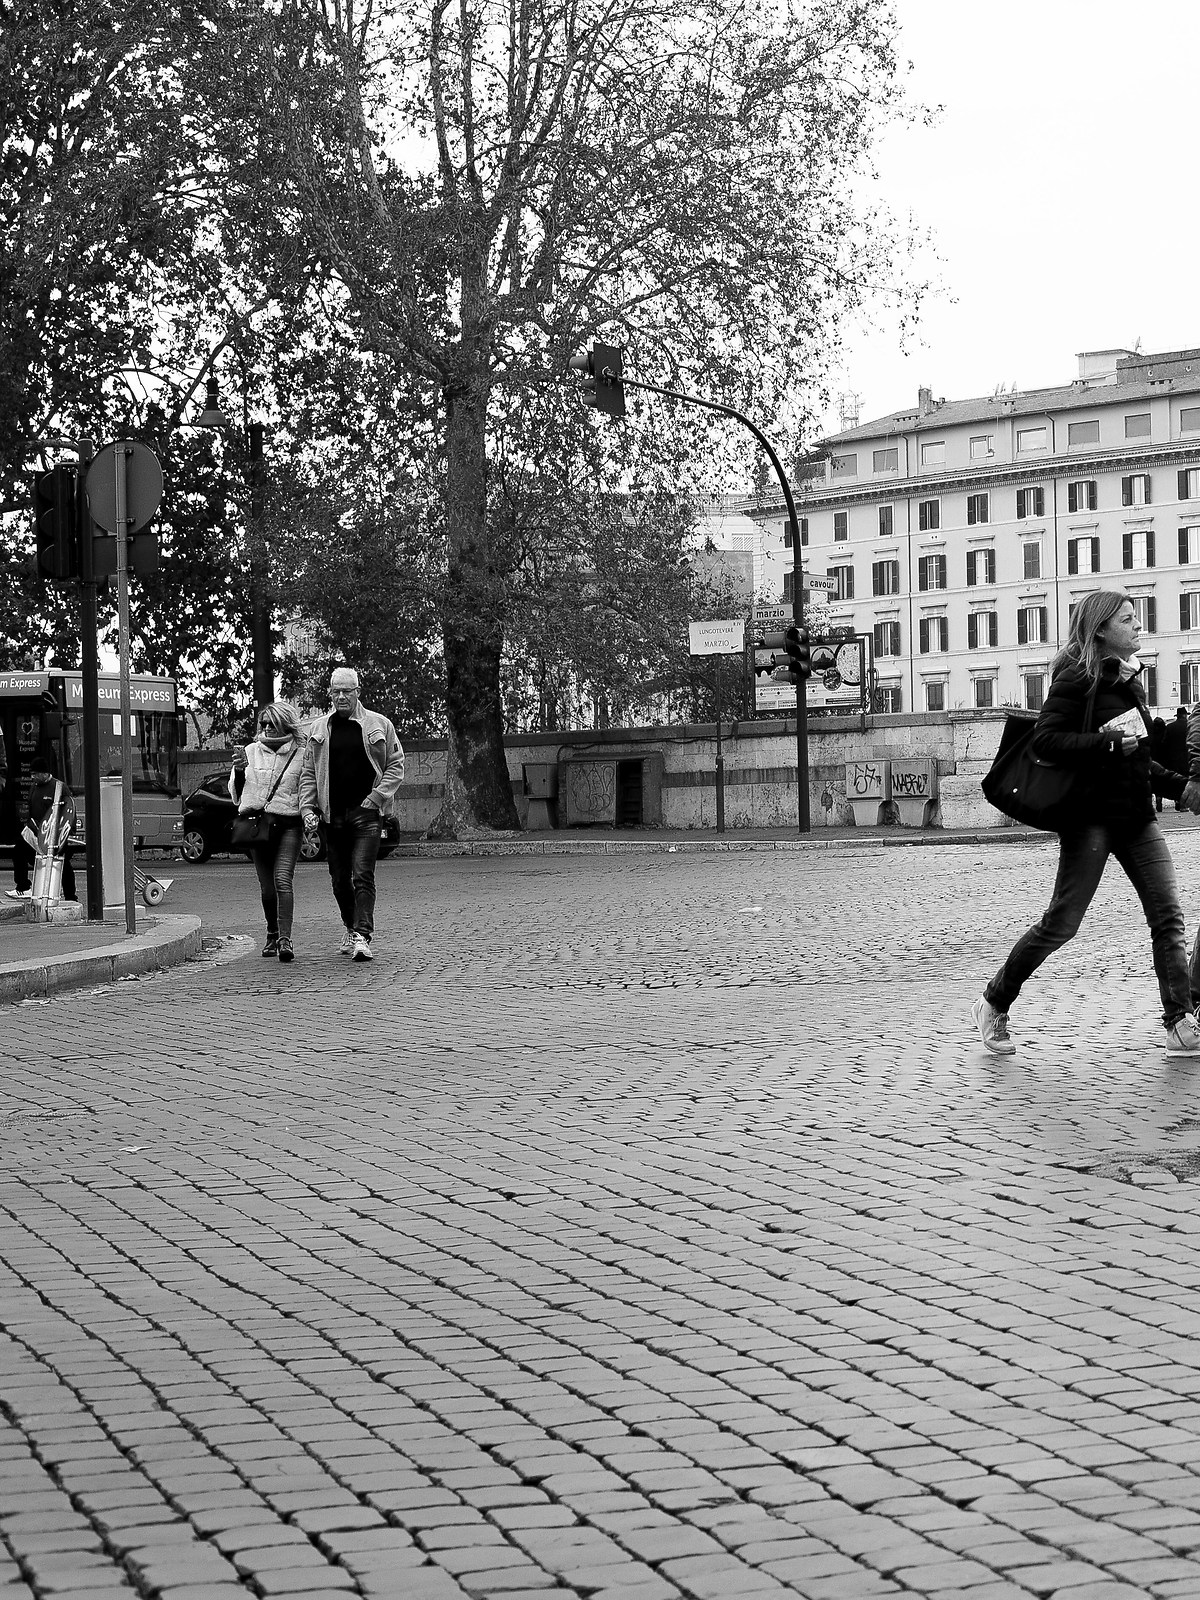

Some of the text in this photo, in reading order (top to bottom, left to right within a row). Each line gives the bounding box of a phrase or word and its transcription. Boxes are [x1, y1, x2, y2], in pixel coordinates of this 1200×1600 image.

[810, 580, 834, 589] cavour
[756, 608, 785, 618] marzio
[704, 639, 730, 648] MARZIO
[10, 677, 41, 690] Express
[72, 683, 170, 703] Meum Express
